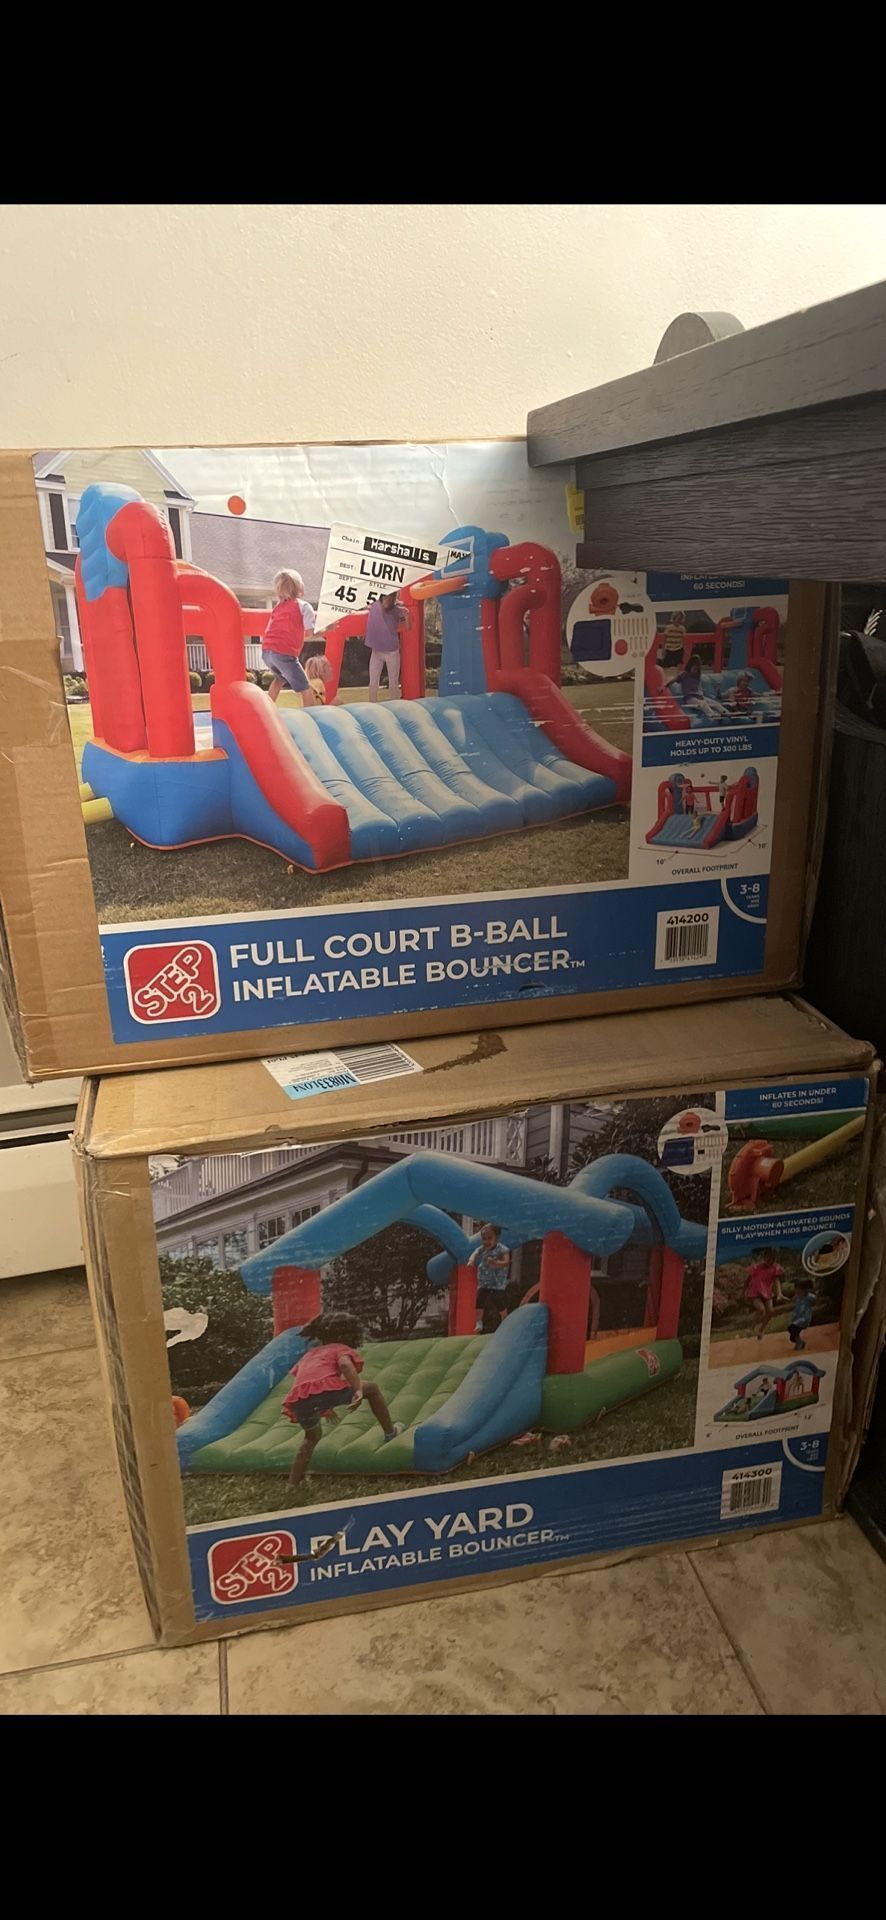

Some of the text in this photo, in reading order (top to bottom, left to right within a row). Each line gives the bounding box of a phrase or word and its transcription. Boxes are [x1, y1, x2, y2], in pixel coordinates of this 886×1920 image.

[370, 538, 431, 561] Marshalls
[360, 558, 405, 583] LURN
[335, 584, 358, 603] 45
[693, 582, 704, 590] 60
[670, 748, 697, 757] HOLDS
[698, 747, 709, 755] UP
[711, 746, 721, 754] TO
[738, 743, 753, 751] LBS
[675, 735, 749, 748] HEAVY-DUTY VINYL
[672, 863, 738, 876] OVERALL FOOTPRINT
[739, 883, 761, 895] 3-8
[666, 912, 709, 926] 414200
[229, 915, 568, 969] FULL COURT B-BALL
[134, 946, 203, 1017] STEP
[232, 966, 417, 1003] INFLATABLE
[181, 981, 214, 1015] 2
[759, 1087, 837, 1101] INFLATES IN UNDER
[783, 1097, 824, 1108] SECONDS!
[721, 1212, 851, 1235] SILLY MOTION-ACTIVATED SOUNDS
[735, 1222, 836, 1240] PLAY WHEN KIDS BOUNCE!
[735, 1424, 800, 1440] OVERALL FOOTPRINT
[800, 1440, 820, 1451] 3-8
[732, 1467, 773, 1481] 414300
[310, 1502, 534, 1559] PLAY YARD
[216, 1536, 283, 1598] STEP
[310, 1548, 442, 1582] INFLATABLE
[259, 1563, 293, 1593] 2
